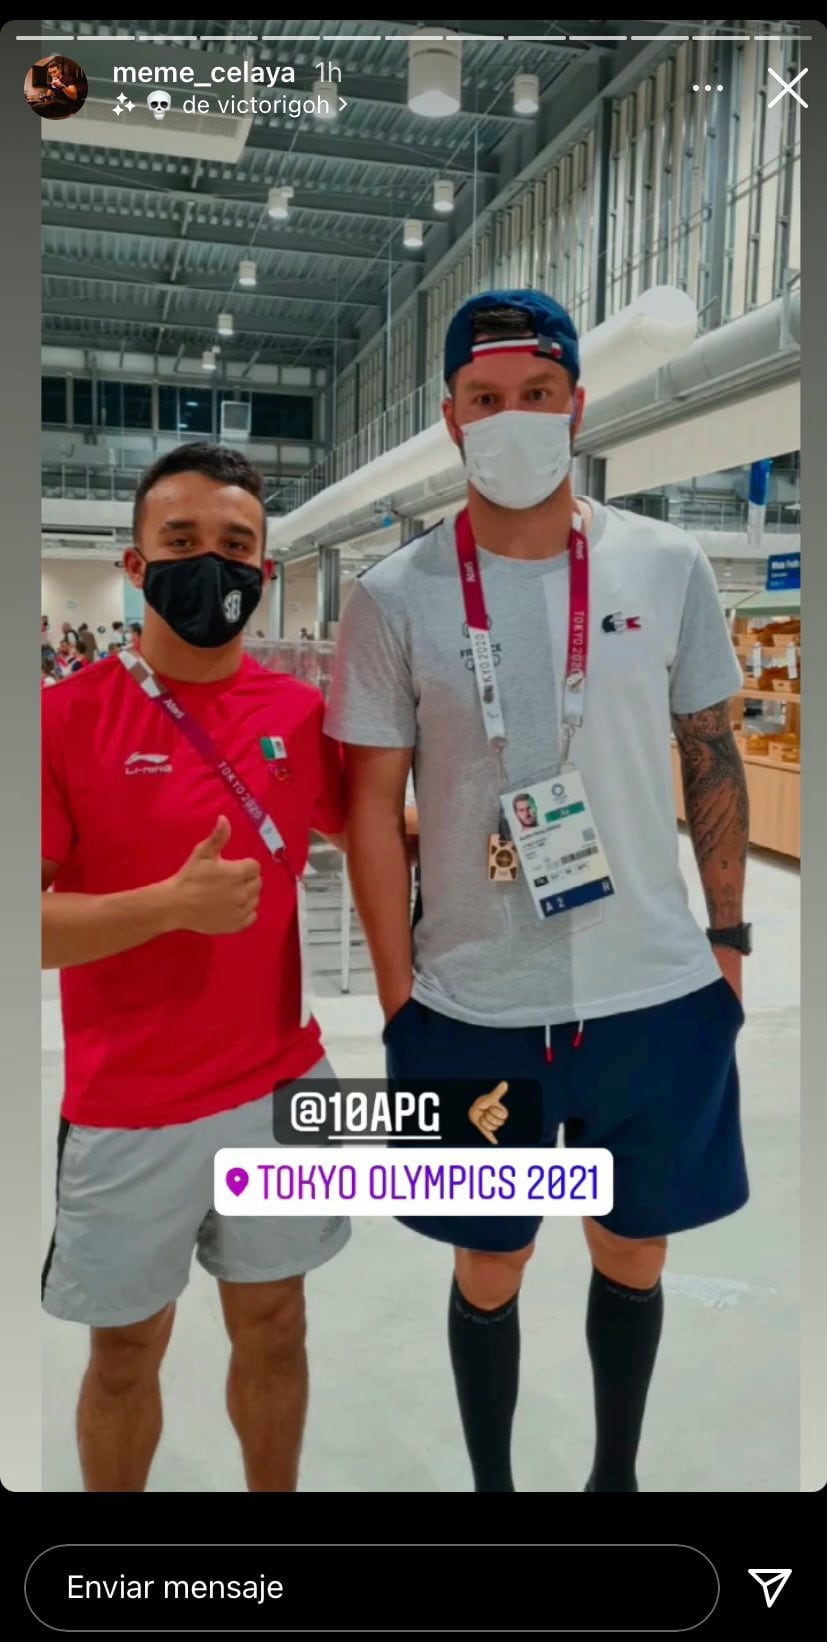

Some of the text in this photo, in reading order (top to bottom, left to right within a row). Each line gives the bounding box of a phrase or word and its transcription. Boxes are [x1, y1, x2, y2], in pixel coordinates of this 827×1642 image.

[572, 610, 586, 645] TOKYO
[217, 762, 263, 819] TOKYO 2020
